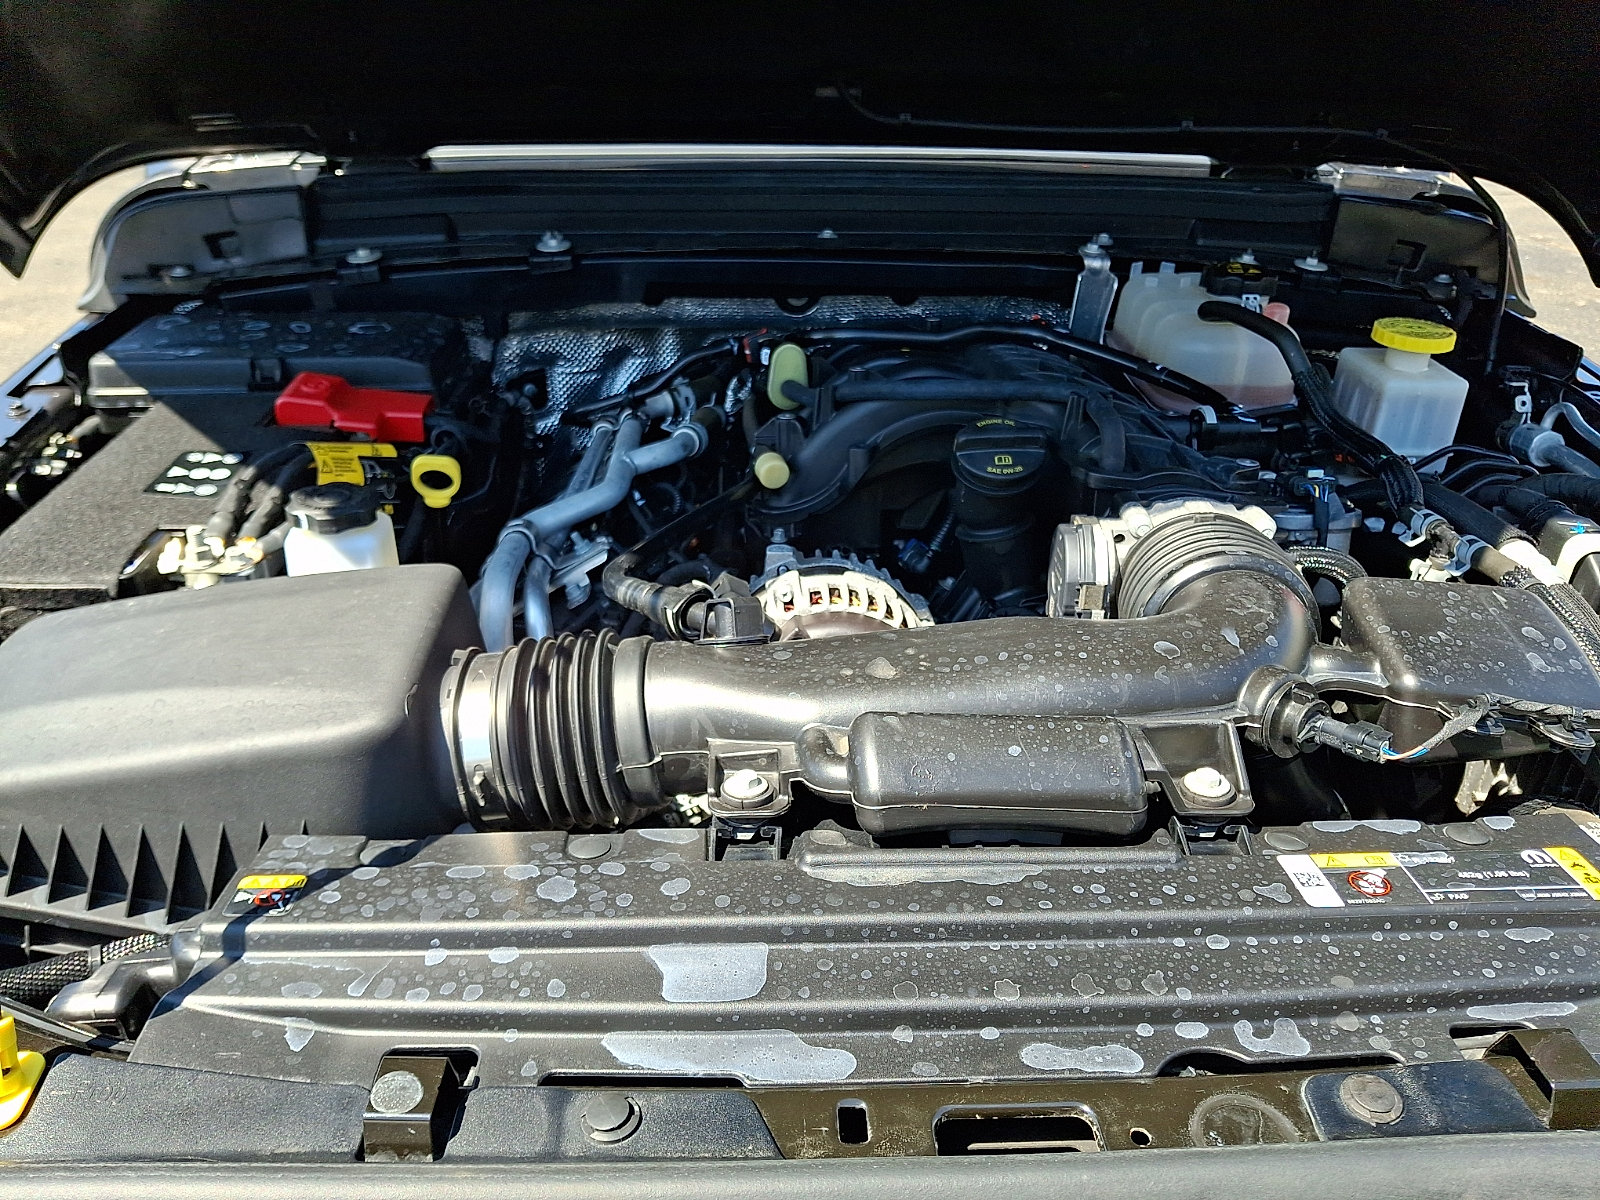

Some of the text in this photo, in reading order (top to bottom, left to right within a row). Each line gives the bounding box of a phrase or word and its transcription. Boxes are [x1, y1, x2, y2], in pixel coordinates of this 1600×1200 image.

[976, 419, 1016, 428] ENGINE OIL
[986, 466, 1023, 475] SAE 0W-20
